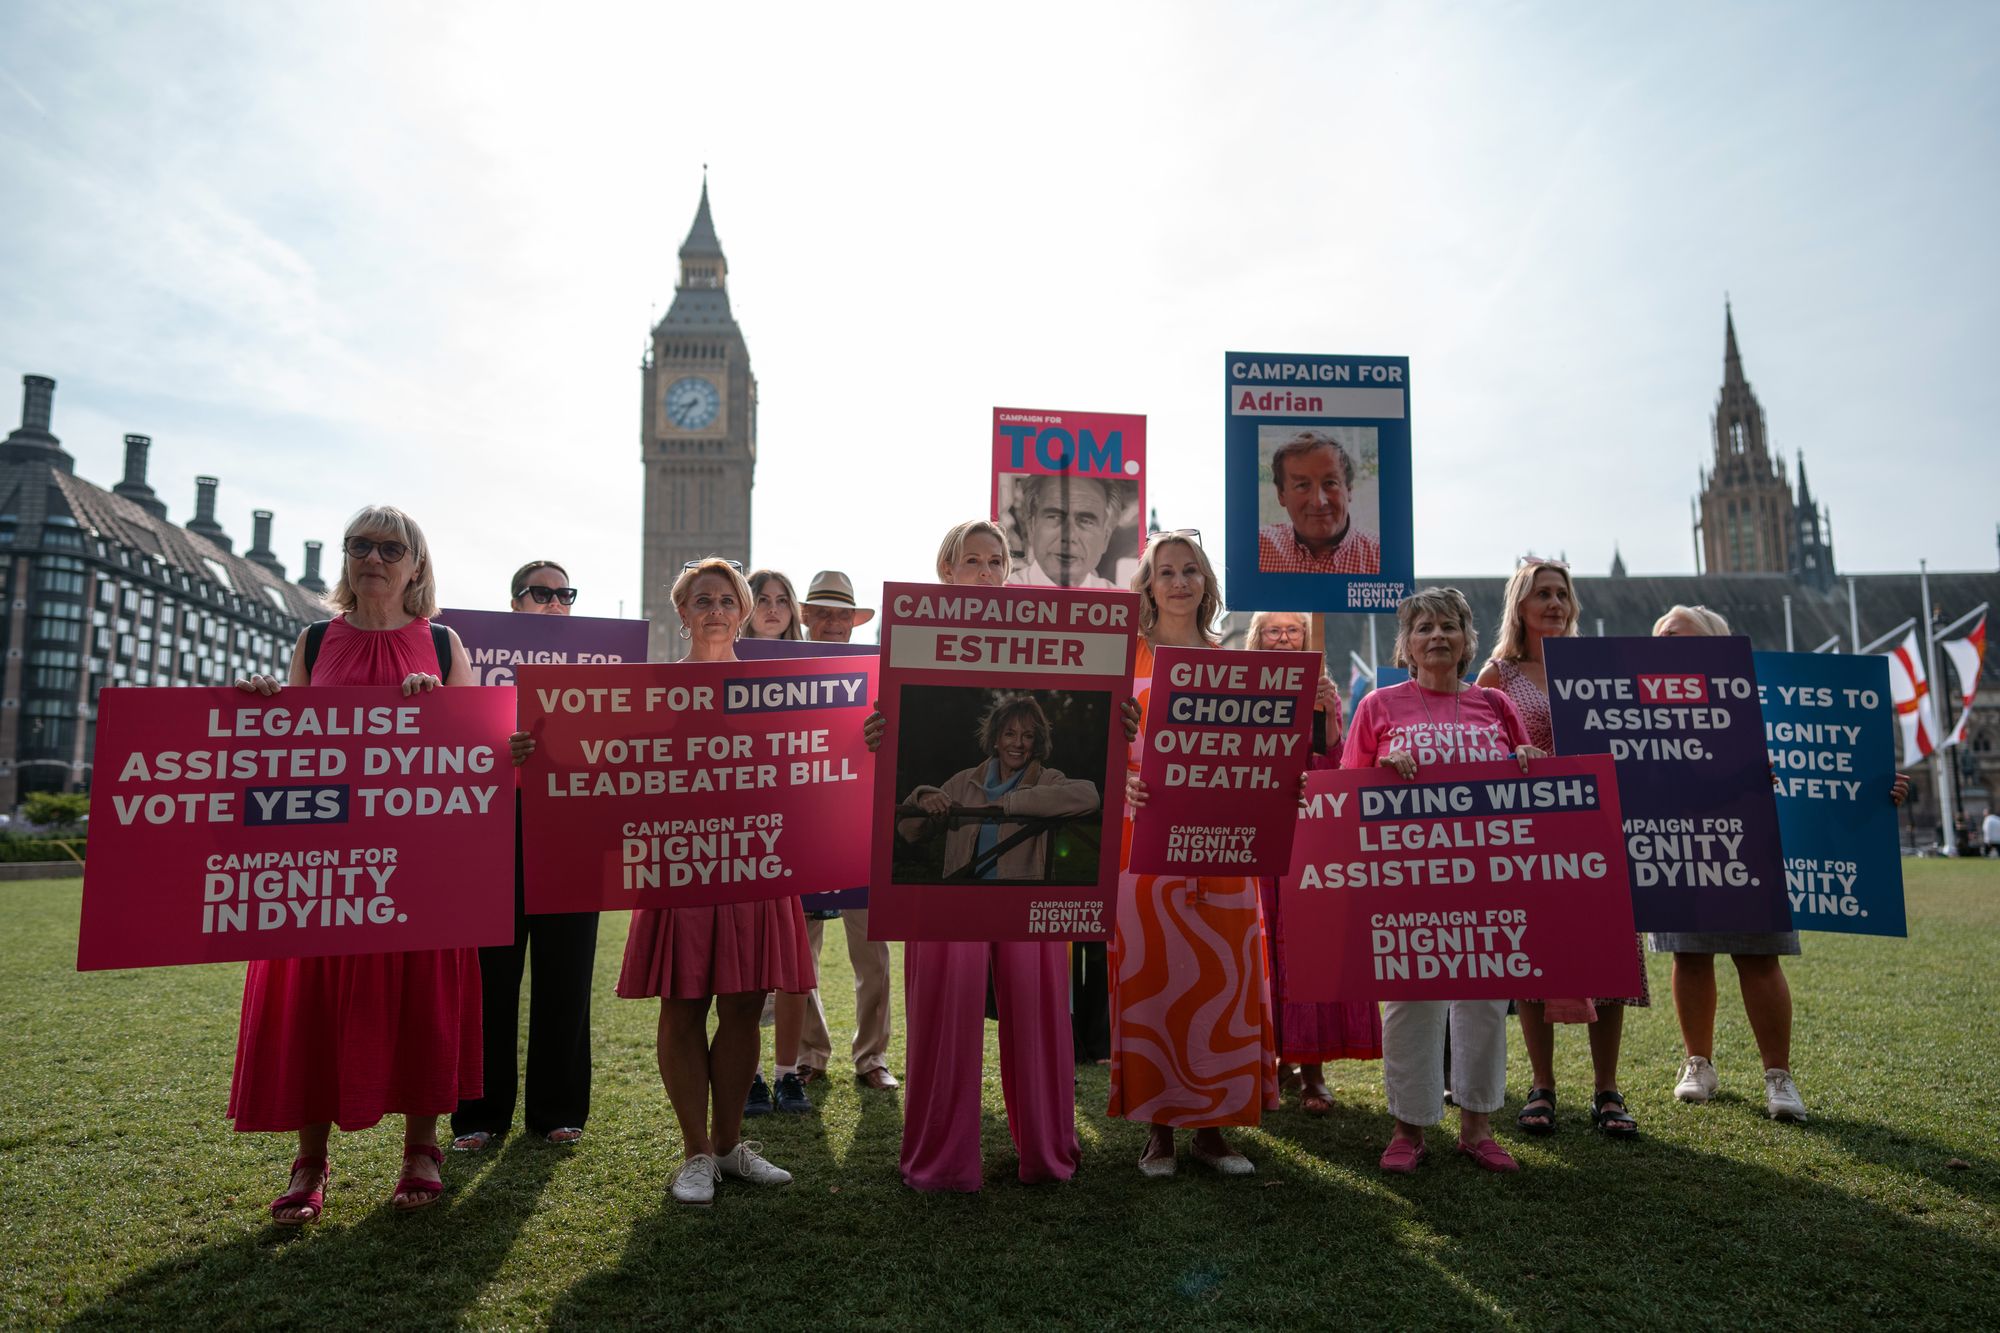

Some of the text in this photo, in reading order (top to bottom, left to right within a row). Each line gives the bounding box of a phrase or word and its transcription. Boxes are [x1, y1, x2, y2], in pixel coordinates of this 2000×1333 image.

[1232, 362, 1403, 382] CAMPAIGN FOR
[1238, 391, 1323, 412] Adrian
[1000, 414, 1043, 423] CAMPAIGN
[1000, 425, 1140, 475] TOM.
[1348, 588, 1404, 598] DIGNITY
[1348, 598, 1361, 607] IN
[893, 595, 1129, 628] CAMPAIGN FOR
[464, 647, 622, 664] AMPAIGN FOR
[935, 634, 1085, 667] ESTHER
[1170, 663, 1305, 691] GIVE ME
[1554, 678, 1633, 700] VOTE
[1641, 677, 1702, 700] YES
[1711, 677, 1751, 700] TO
[536, 679, 863, 713] VOTE FOR DIGNITY
[1777, 686, 1833, 707] YES
[1842, 689, 1879, 709] TO
[207, 707, 420, 737] LEGALISE
[1171, 697, 1294, 724] CHOICE
[1584, 708, 1731, 730] ASSISTED
[1387, 722, 1499, 737] CAMPAIGN FR
[1389, 730, 1499, 753] DIGNITY
[1766, 722, 1862, 745] IGNITY
[580, 729, 829, 764] VOTE FOR THE
[1154, 730, 1300, 757] OVER MY
[1609, 738, 1713, 761] DYING.
[118, 745, 495, 782] ASSISTED DYING
[1767, 749, 1853, 772] HOICE
[548, 758, 857, 797] LEADBEATER BILL
[1165, 764, 1280, 789] DEATH.
[1773, 777, 1862, 801] AFETY
[112, 786, 499, 826] VOTE YES TODAY
[1298, 779, 1596, 819] MY DYING WISH:
[622, 813, 783, 837] CAMPAIGN FOR
[1170, 825, 1256, 835] CAMPAIGN FOR
[1358, 818, 1535, 852] LEGALISE
[1621, 818, 1743, 833] MPAIGN FOR
[623, 828, 783, 864] DIGNITY
[1168, 834, 1255, 849] DIGNITY
[1628, 834, 1744, 860] GNITY
[206, 847, 398, 871] CAMPAIGN FOR
[1167, 848, 1257, 863] IN DYING.
[1824, 860, 1857, 874] FOR
[204, 865, 397, 902] DIGNITY
[623, 855, 793, 890] IN DYING.
[1299, 852, 1607, 890] ASSISTED DYING
[1635, 861, 1760, 887] DYING.
[1785, 870, 1857, 895] NITY
[202, 895, 408, 933] IN DYING.
[1029, 909, 1103, 920] DIGNITY
[1788, 891, 1868, 917] YING.
[1028, 921, 1106, 933] IN DYING.
[1370, 909, 1527, 928] CAMPAIGN FOR
[1371, 925, 1527, 954] DIGNITY
[1373, 952, 1543, 980] IN DYING.
